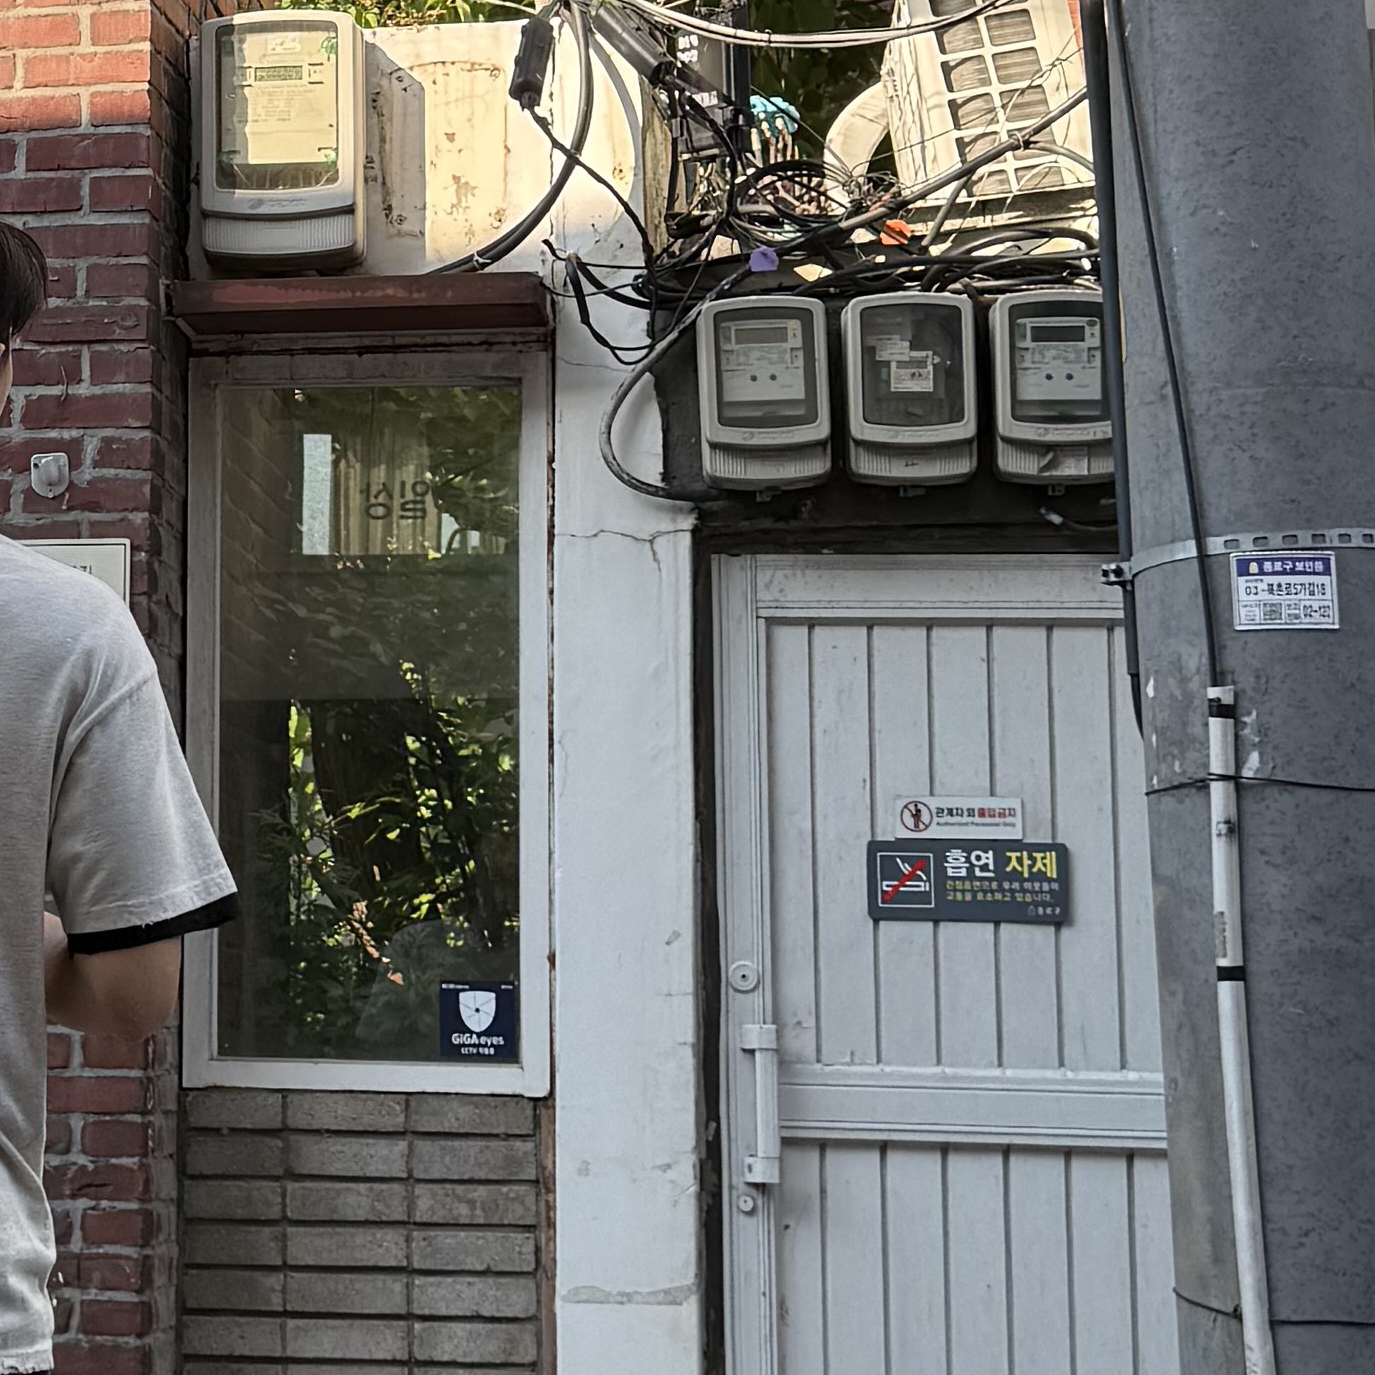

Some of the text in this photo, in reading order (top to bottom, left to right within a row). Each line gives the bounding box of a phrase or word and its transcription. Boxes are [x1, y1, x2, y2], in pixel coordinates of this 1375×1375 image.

[943, 848, 1058, 879] 흡연 자제
[479, 1035, 505, 1047] eyes
